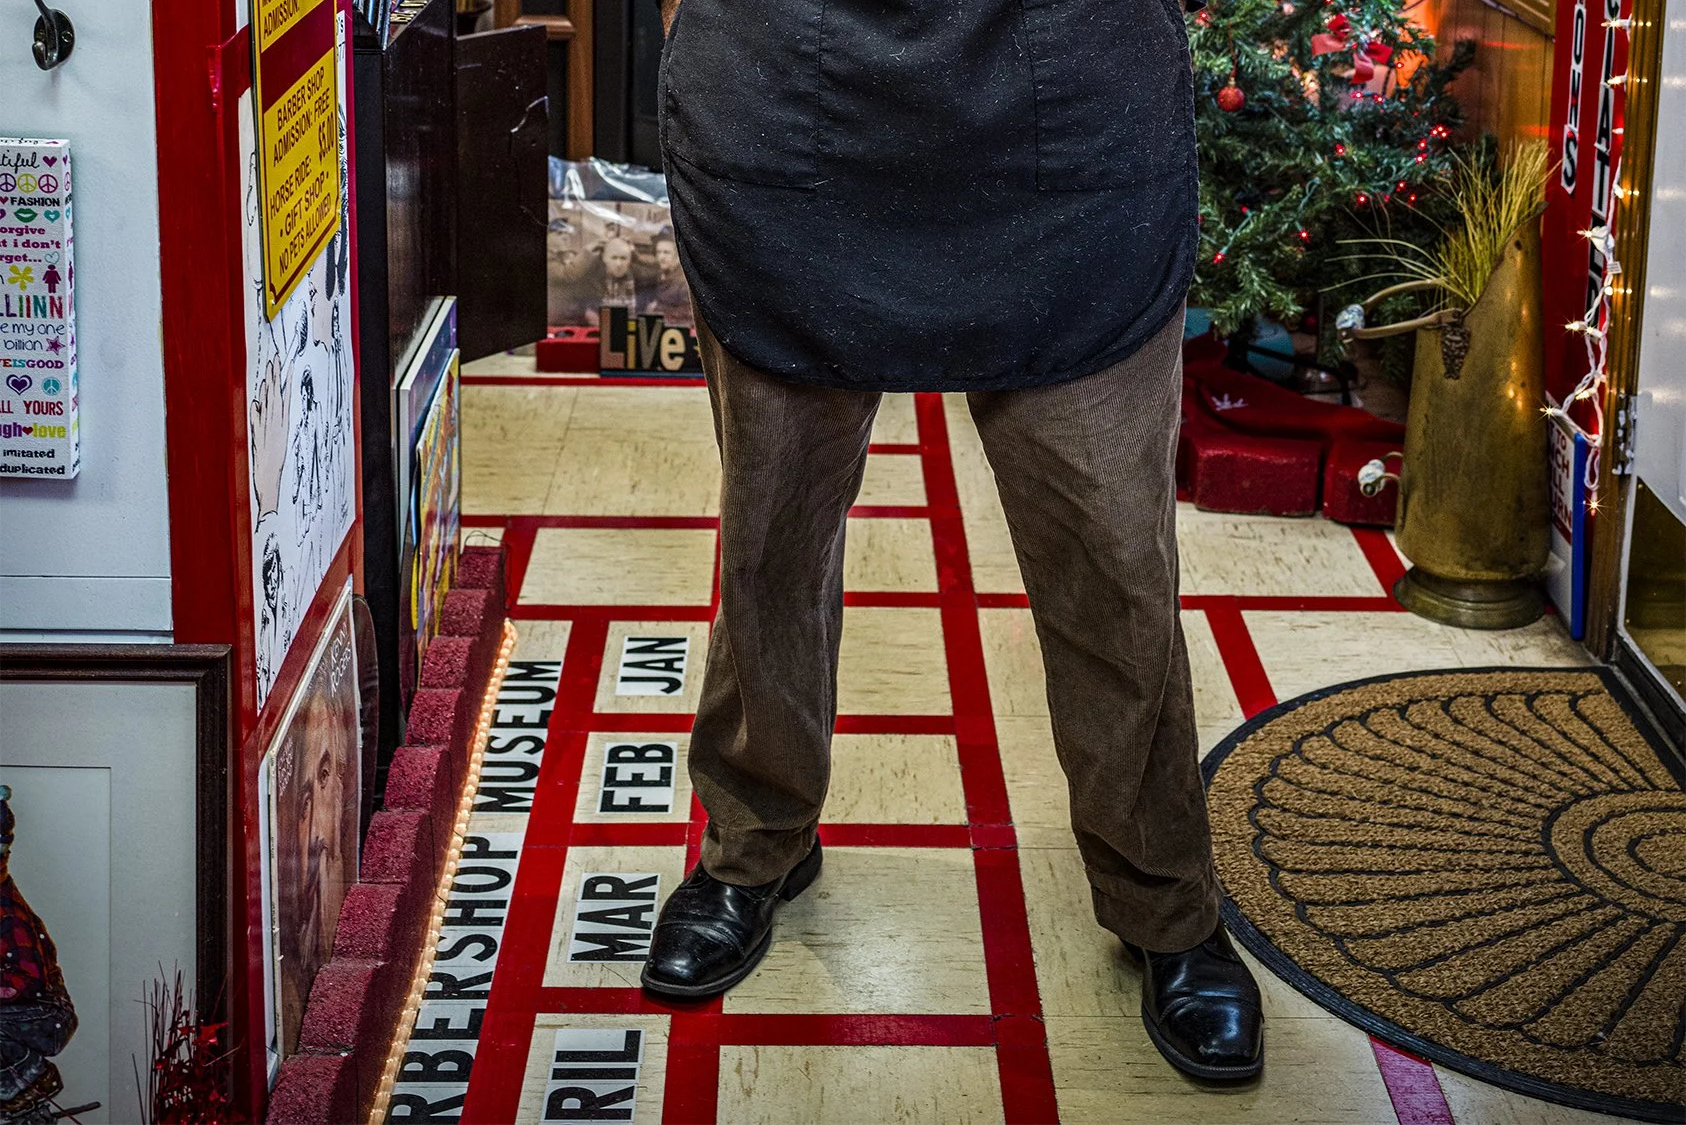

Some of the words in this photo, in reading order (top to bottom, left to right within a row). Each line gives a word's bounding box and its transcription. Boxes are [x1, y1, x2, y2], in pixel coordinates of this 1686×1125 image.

[273, 107, 313, 167] ADMISSION:
[314, 87, 330, 122] FREE
[277, 86, 305, 131] BARBER
[307, 66, 324, 99] SHOP
[270, 176, 293, 220] HORSE
[294, 155, 312, 189] RIDE:
[318, 111, 334, 164] $5.00
[0, 225, 46, 236] orgive
[10, 197, 61, 207] FASHION
[285, 197, 302, 238] GIFT
[305, 177, 325, 213] SHOP
[13, 239, 19, 248] i
[22, 239, 61, 249] don't
[279, 241, 289, 277] NO
[289, 226, 306, 257] PETS
[306, 192, 331, 239] ALLOWED
[3, 338, 43, 350] billion
[12, 323, 34, 336] my
[37, 323, 65, 335] one
[601, 307, 686, 371] Live
[23, 400, 64, 416] YOURS
[0, 464, 65, 475] duplicated
[3, 449, 55, 458] imitated
[620, 636, 688, 695] JAN
[471, 660, 561, 813] MUSEUM
[599, 742, 675, 813] FEB
[570, 874, 659, 962] MAR
[544, 1029, 642, 1125] RIL
